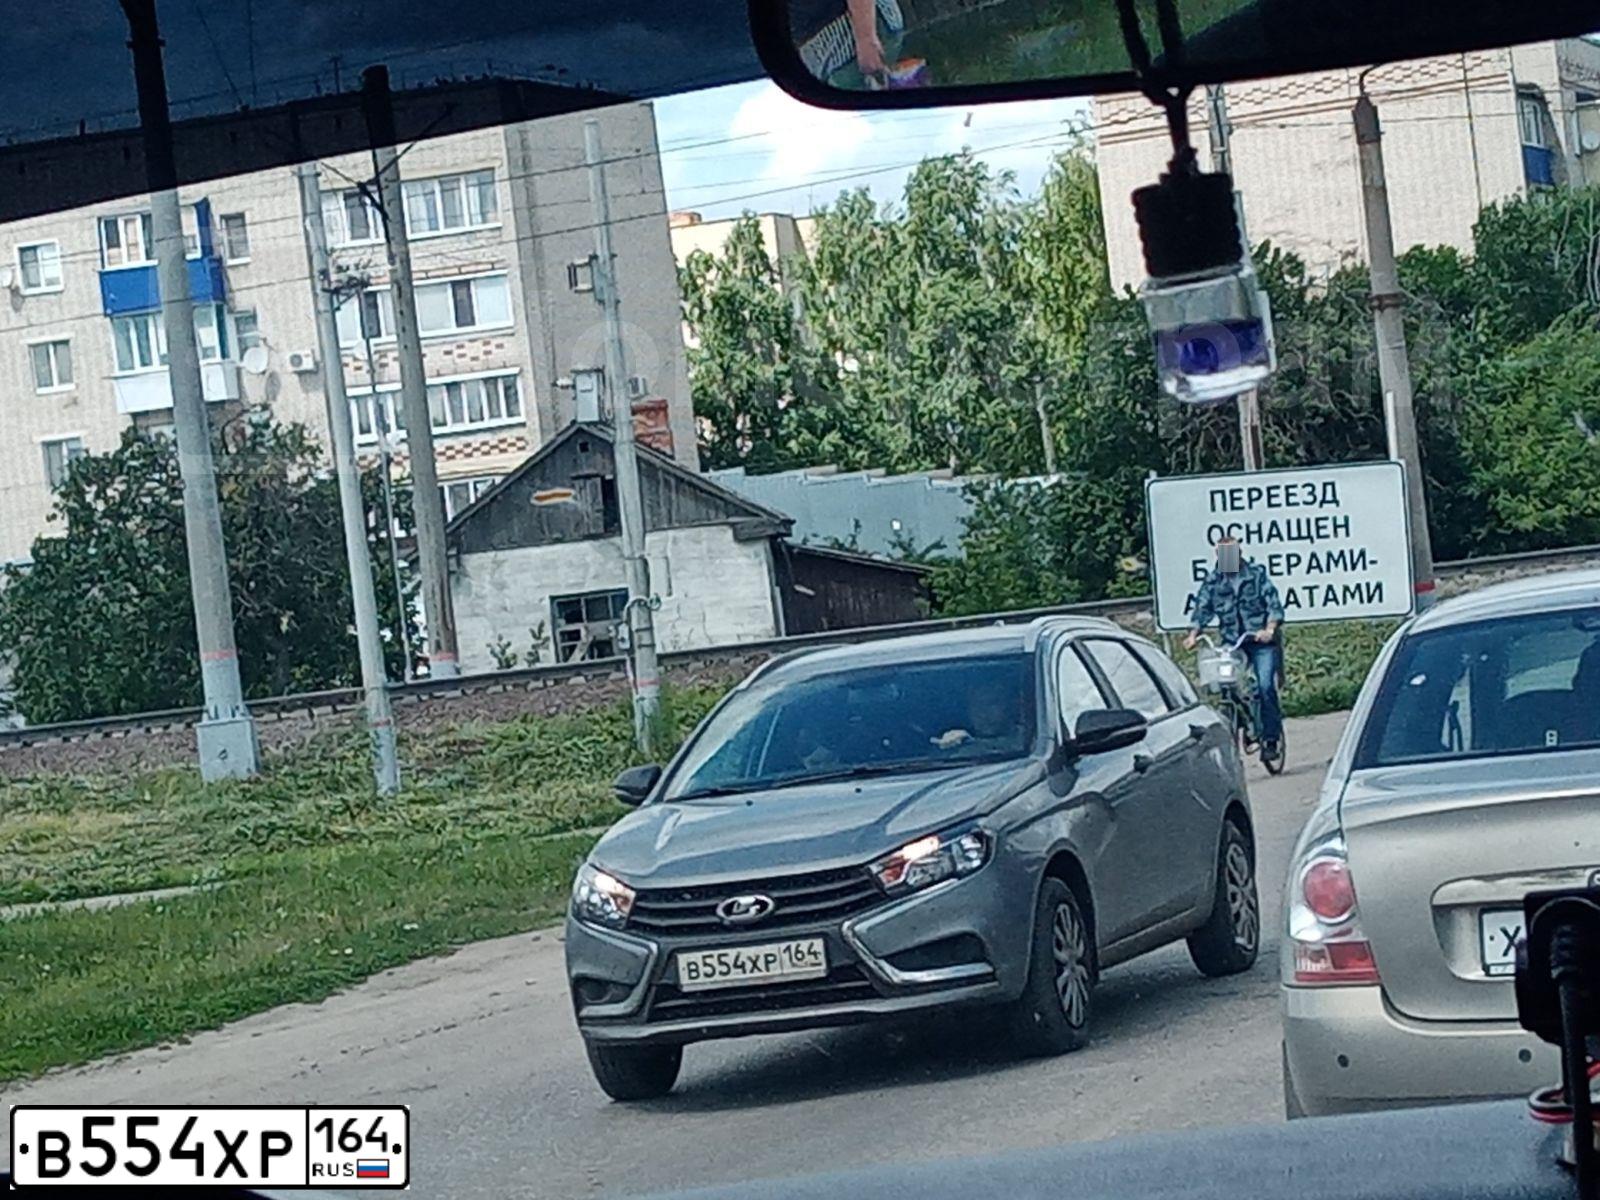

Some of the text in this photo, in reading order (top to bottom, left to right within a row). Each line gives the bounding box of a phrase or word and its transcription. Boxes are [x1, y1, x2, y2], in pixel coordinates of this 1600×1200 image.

[1209, 482, 1340, 512] ПЕРЕЕЗД
[1206, 515, 1350, 547] ОСНАЩЕН
[1191, 548, 1378, 582] БЕРАМИ-
[1183, 582, 1384, 616] ААТАМИ
[687, 942, 822, 980] В554ХР 164
